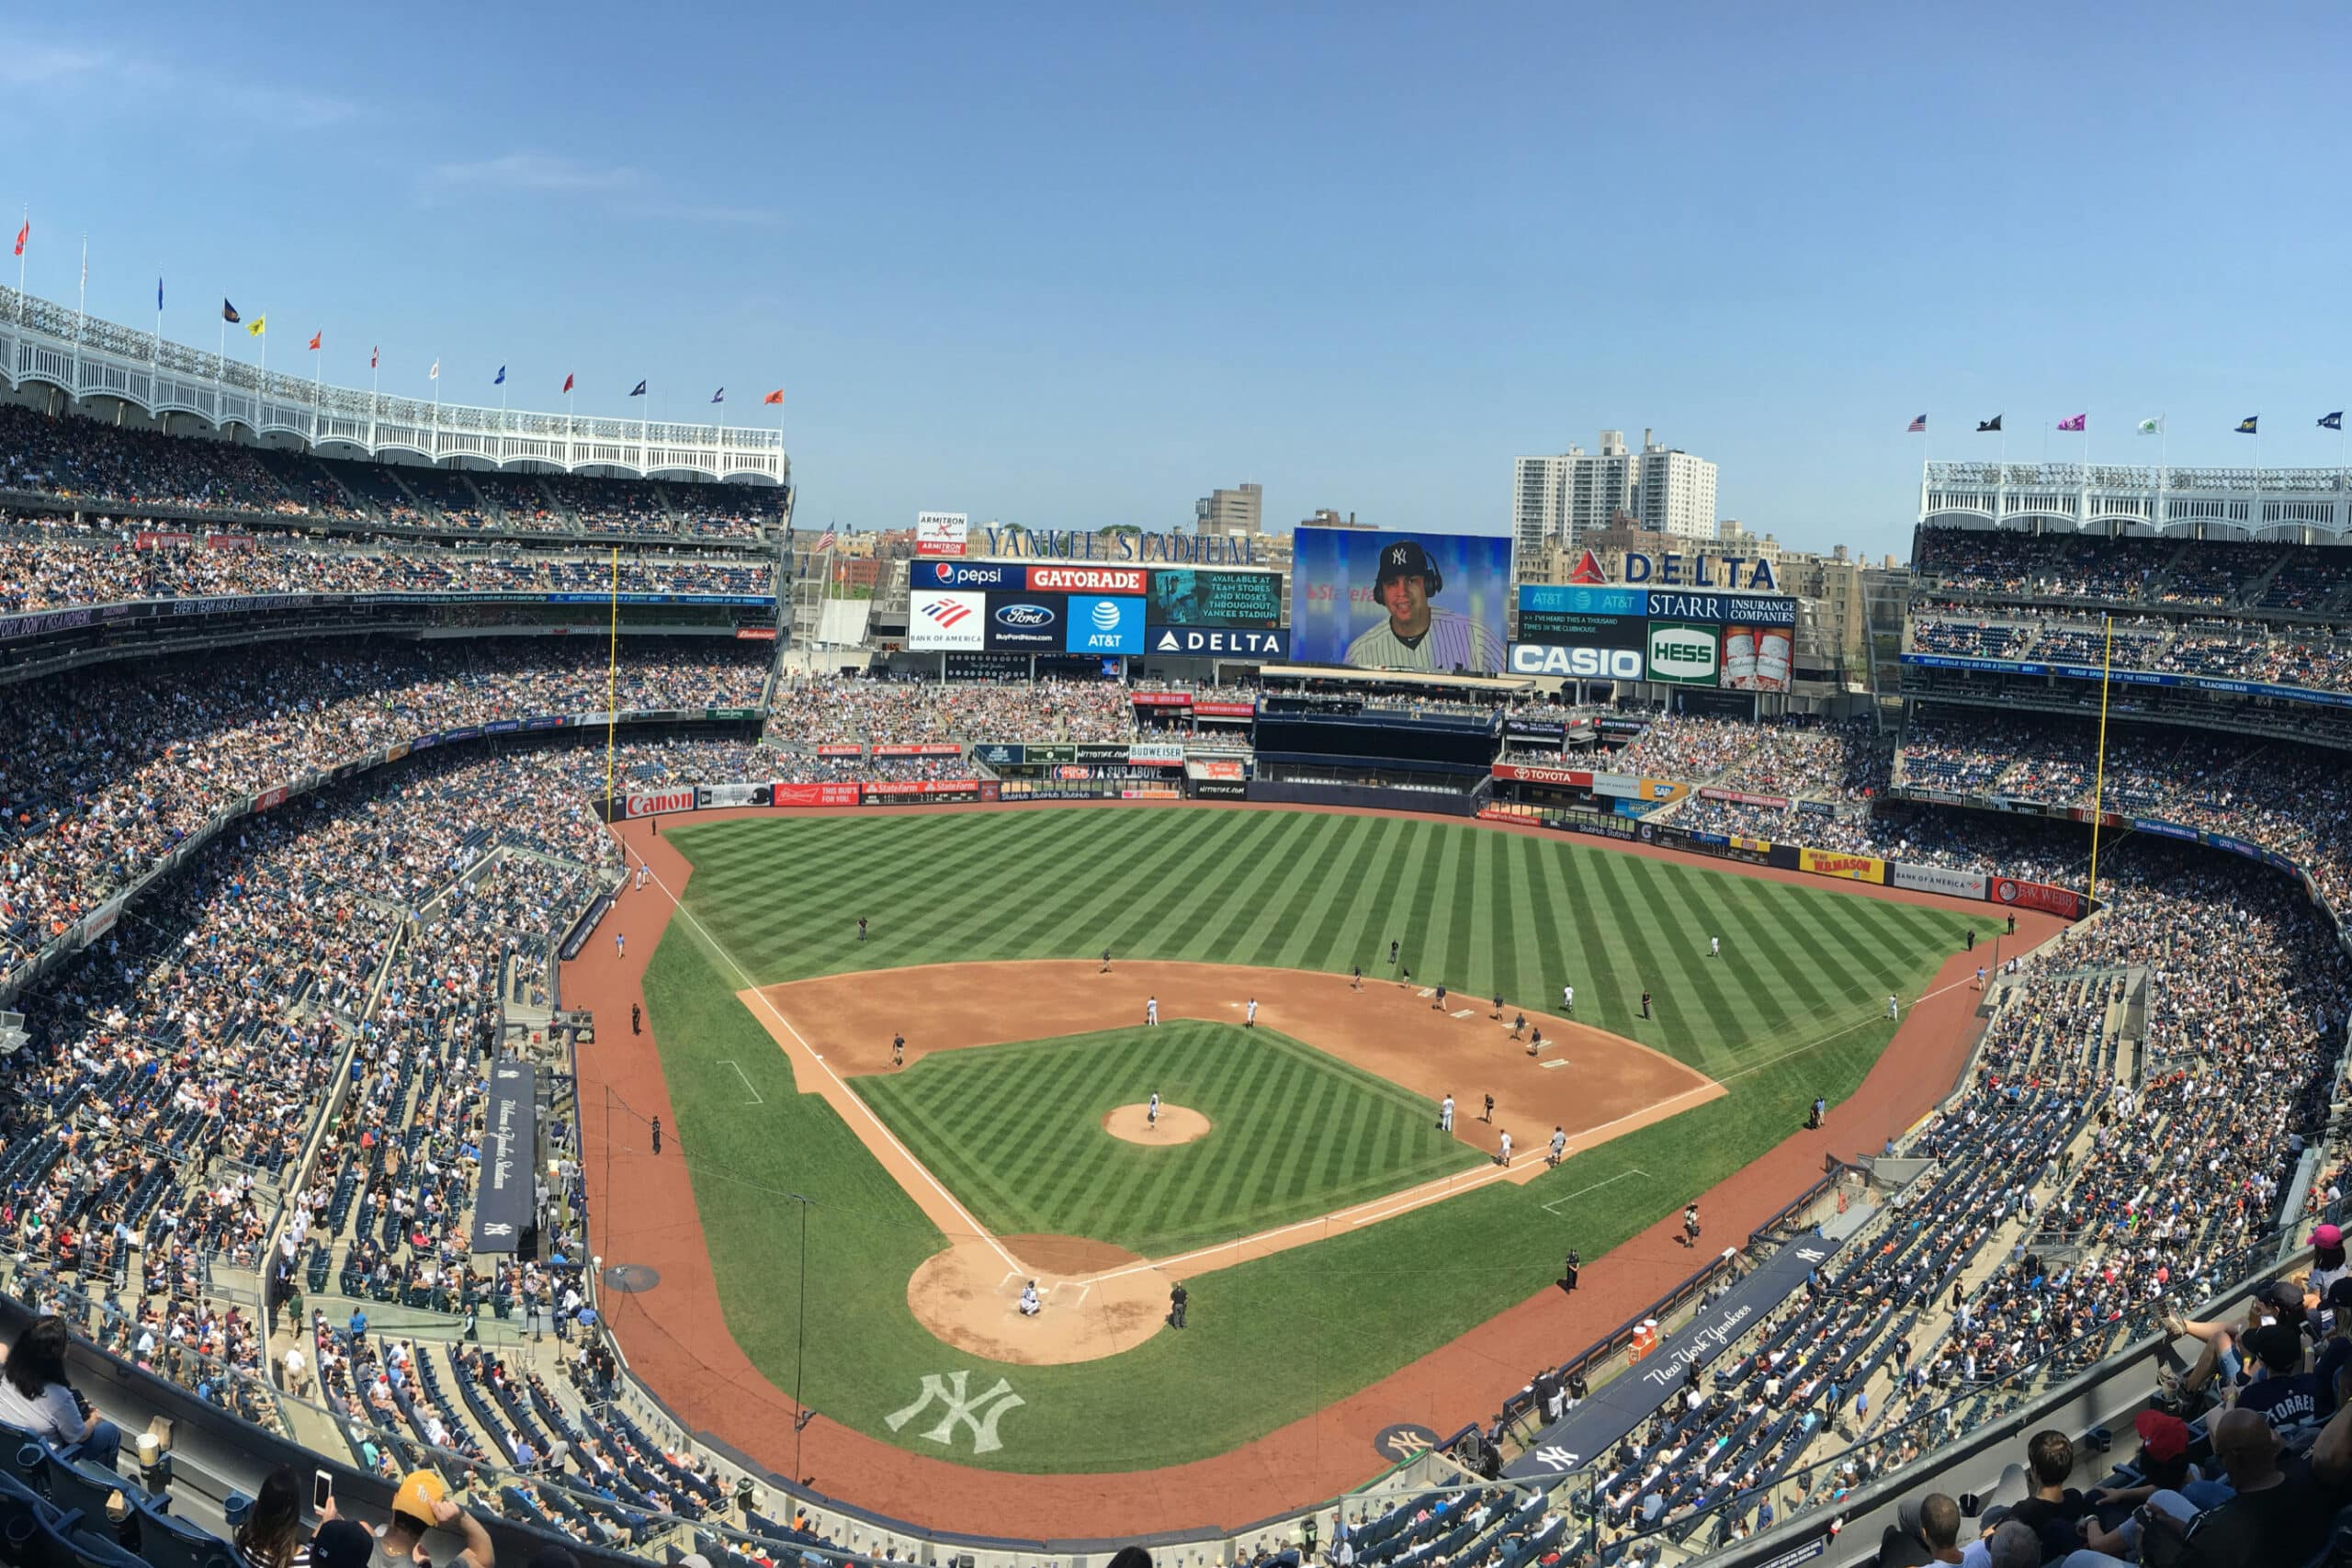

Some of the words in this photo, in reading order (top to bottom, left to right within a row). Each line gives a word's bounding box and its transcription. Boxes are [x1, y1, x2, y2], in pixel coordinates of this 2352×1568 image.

[921, 515, 965, 525] ARMITRON
[922, 543, 962, 551] ARMITRON
[986, 527, 1100, 559] YANKEE
[1117, 532, 1251, 566] STADIUM
[1392, 547, 1407, 565] NY
[957, 568, 1001, 585] pepsi
[1212, 575, 1258, 583] AVAILABLE
[1625, 552, 1777, 590] DELTA
[1034, 570, 1139, 589] GATORADE
[1209, 602, 1272, 610] THROUGHOUT
[1532, 592, 1563, 605] AT&T
[1602, 595, 1635, 608] AT&T
[1649, 594, 1722, 619] STARR
[1731, 599, 1796, 612] INSURANCE
[1007, 607, 1043, 625] Ford
[1203, 610, 1237, 618] YANKEE
[1238, 611, 1276, 619] STADIUM
[1730, 609, 1795, 623] COMPANIES
[1523, 623, 1542, 631] TIMES
[1088, 634, 1123, 648] AT&T
[1188, 632, 1280, 653] DELTA
[1655, 642, 1712, 663] HESS
[1514, 645, 1642, 678] CASIO
[1131, 746, 1181, 758] BUDWEISER
[1128, 766, 1162, 779] ABOVE
[1531, 769, 1571, 783] TOYOTA
[822, 786, 837, 795] THIS
[1001, 793, 1029, 801] StubHub
[1031, 791, 1059, 800] StubHub
[1061, 791, 1090, 799] StubHub
[1655, 785, 1671, 796] SAP
[628, 793, 693, 816] Canon
[821, 795, 834, 803] FOR
[1579, 824, 1605, 835] StubHub
[1608, 829, 1632, 840] StubHub
[1641, 824, 1652, 839] G
[1896, 872, 1917, 881] BANK
[1918, 874, 1928, 883] OF
[1929, 876, 1965, 889] AMERICA
[2041, 888, 2074, 907] WEBB
[488, 1133, 515, 1158] Yankee
[493, 1157, 514, 1190] Stadium
[1795, 1247, 1826, 1263] NY
[1643, 1362, 1682, 1386] New
[1670, 1336, 1711, 1364] York
[1699, 1304, 1752, 1344] Yankees
[885, 1370, 1025, 1454] NY
[2267, 1394, 2315, 1423] TORRES
[1387, 1430, 1434, 1459] NY
[1535, 1446, 1579, 1471] NY
